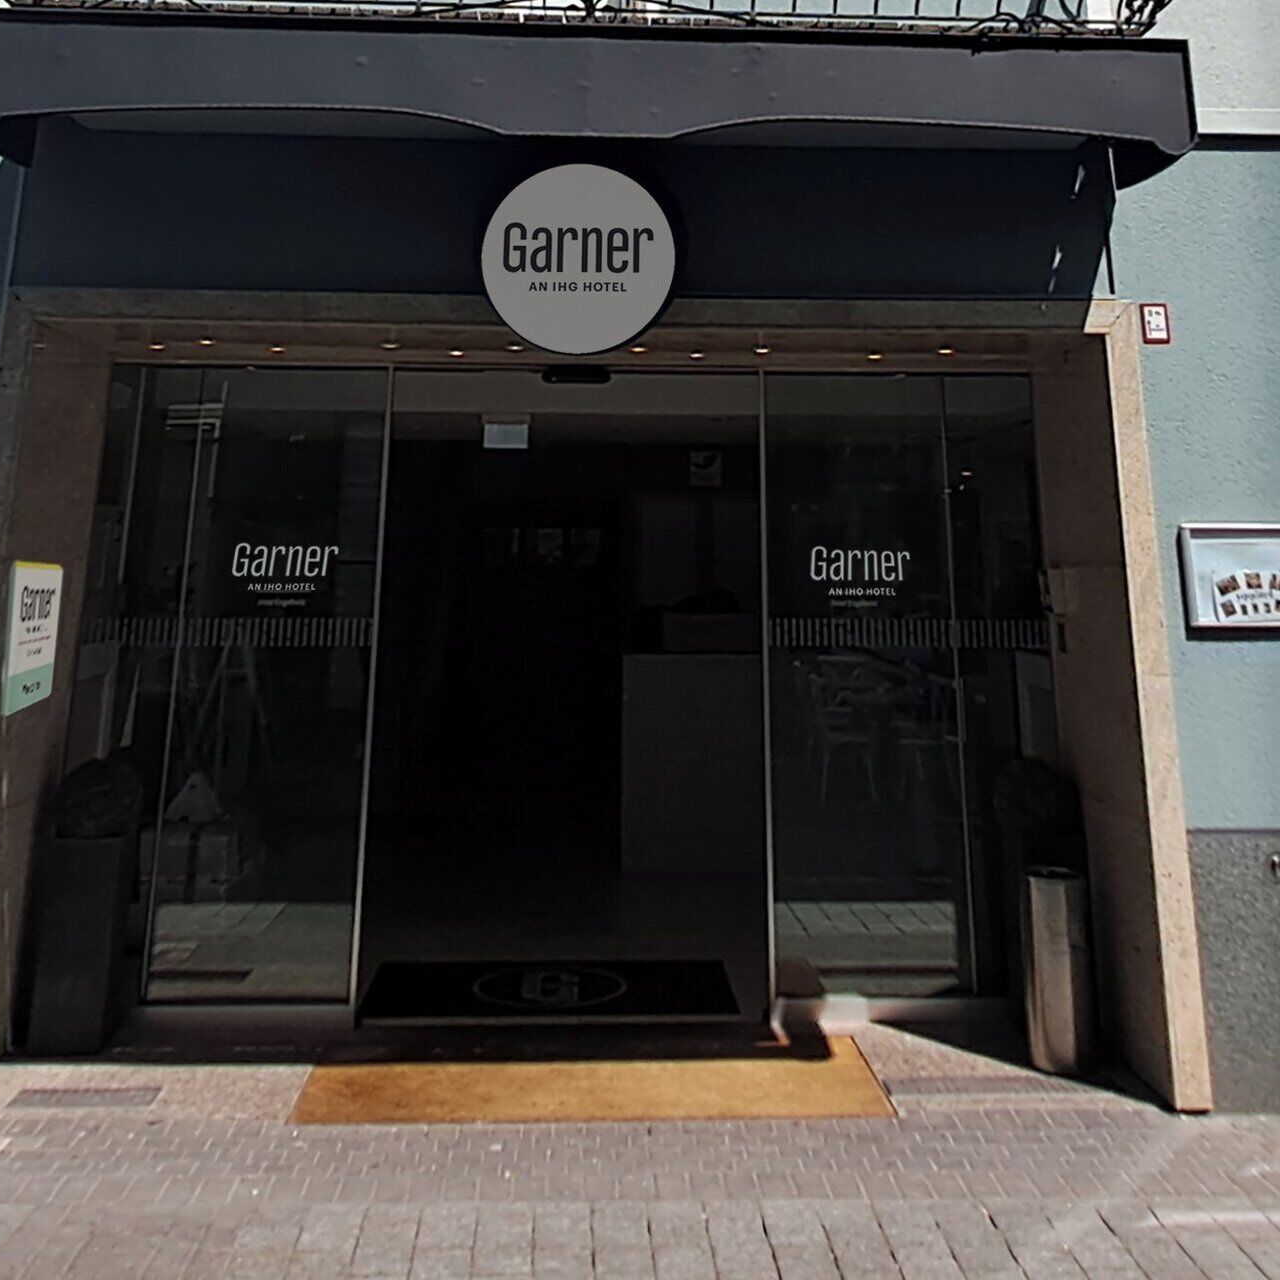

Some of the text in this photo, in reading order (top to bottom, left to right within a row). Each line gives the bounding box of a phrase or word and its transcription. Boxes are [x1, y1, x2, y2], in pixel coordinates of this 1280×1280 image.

[502, 221, 655, 274] Garner
[528, 281, 628, 293] AN IHG HOTEL
[231, 542, 340, 577] Garner
[809, 545, 912, 582] Garner
[246, 583, 261, 591] AN
[285, 583, 317, 591] HOTEL
[828, 587, 843, 596] AN
[866, 587, 897, 596] HOTEL
